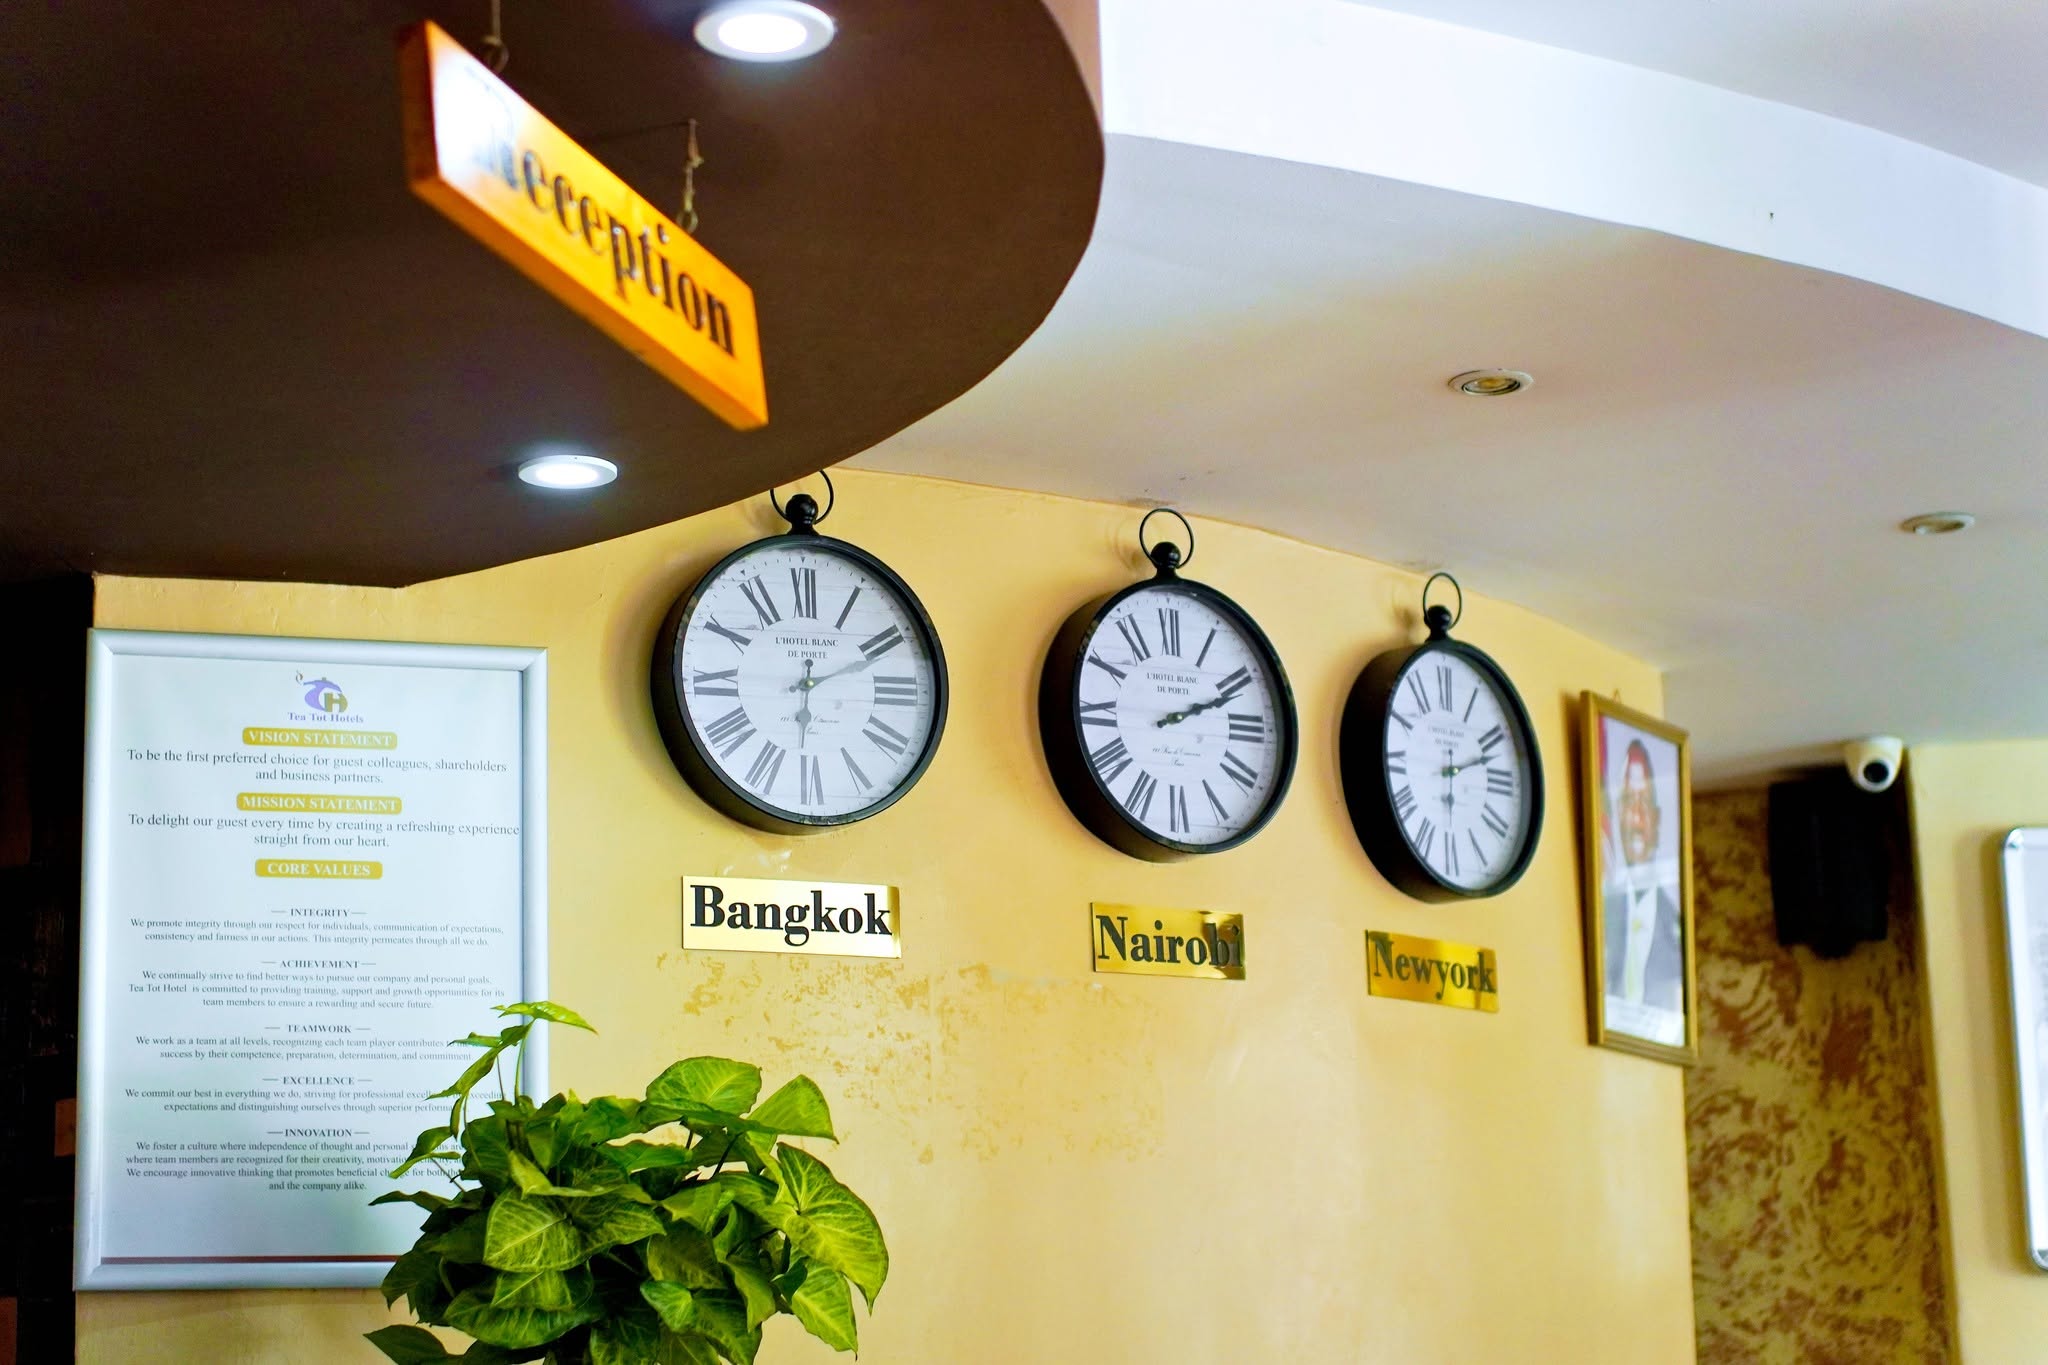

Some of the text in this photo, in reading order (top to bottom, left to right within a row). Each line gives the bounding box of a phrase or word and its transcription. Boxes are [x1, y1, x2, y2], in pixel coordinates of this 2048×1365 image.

[738, 574, 784, 631] XI
[790, 568, 818, 620] XII
[834, 586, 862, 631] I
[703, 614, 752, 655] X
[775, 636, 839, 647] L'HOTEL BLANC
[857, 624, 905, 660] II
[1115, 614, 1152, 666] XI
[1158, 608, 1182, 658] XII
[1196, 628, 1217, 668] I
[788, 650, 828, 660] DE PORTE
[1088, 648, 1128, 688] X
[693, 666, 740, 698] IX
[873, 676, 918, 706] III
[1146, 672, 1200, 684] L'HOTEL BLANC
[1157, 686, 1190, 695] DE PORTE
[1216, 666, 1252, 696] II
[287, 712, 364, 723] Tea Tot Hotels
[1080, 700, 1118, 727] IX
[1228, 713, 1265, 744] III
[248, 731, 394, 745] VISION STATEMENT
[704, 706, 757, 762] VIII
[862, 714, 910, 764] IV
[127, 749, 508, 771] To be the first preferred choice for guest colleagues, shareholders
[255, 768, 384, 785] and business partners.
[744, 740, 786, 795] VII
[840, 747, 873, 794] V
[1090, 736, 1133, 786] VIII
[1220, 750, 1259, 798] IV
[800, 754, 824, 806] VI
[1124, 769, 1158, 822] VII
[243, 797, 398, 811] MISSION STATEMENT
[1170, 784, 1190, 834] VI
[1202, 778, 1230, 825] V
[128, 814, 520, 836] To delight our guest every time by creating a refreshing experience
[254, 833, 390, 847] straight from our heart.
[267, 863, 372, 875] CORE VALUES
[290, 908, 350, 917] INTEGRITY
[690, 884, 892, 946] Bangkok
[1095, 914, 1243, 967] Nairobi
[279, 960, 360, 968] ACHIEVEMENT
[1374, 938, 1496, 1000] Newyork
[286, 1024, 352, 1033] TEAMWORK
[282, 1076, 356, 1085] EXCELLENCE
